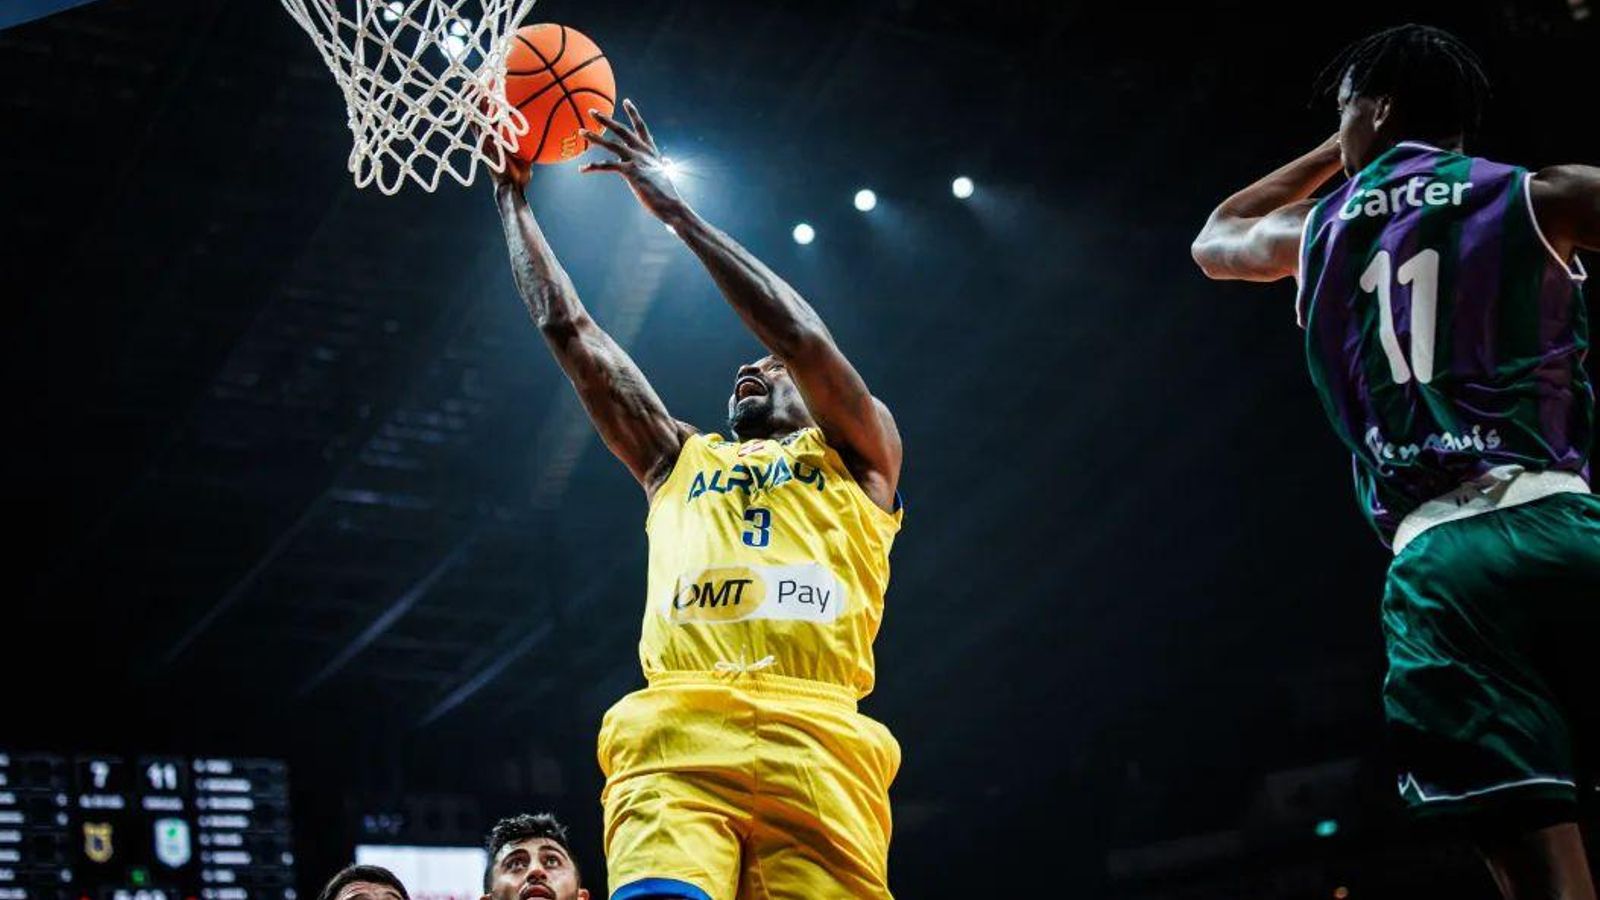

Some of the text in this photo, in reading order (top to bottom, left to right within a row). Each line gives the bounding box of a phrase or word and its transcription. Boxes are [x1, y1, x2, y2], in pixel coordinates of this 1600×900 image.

[1338, 176, 1473, 220] Carter
[1360, 248, 1439, 384] 11
[742, 507, 772, 547] 3
[673, 578, 831, 614] OMT Pay
